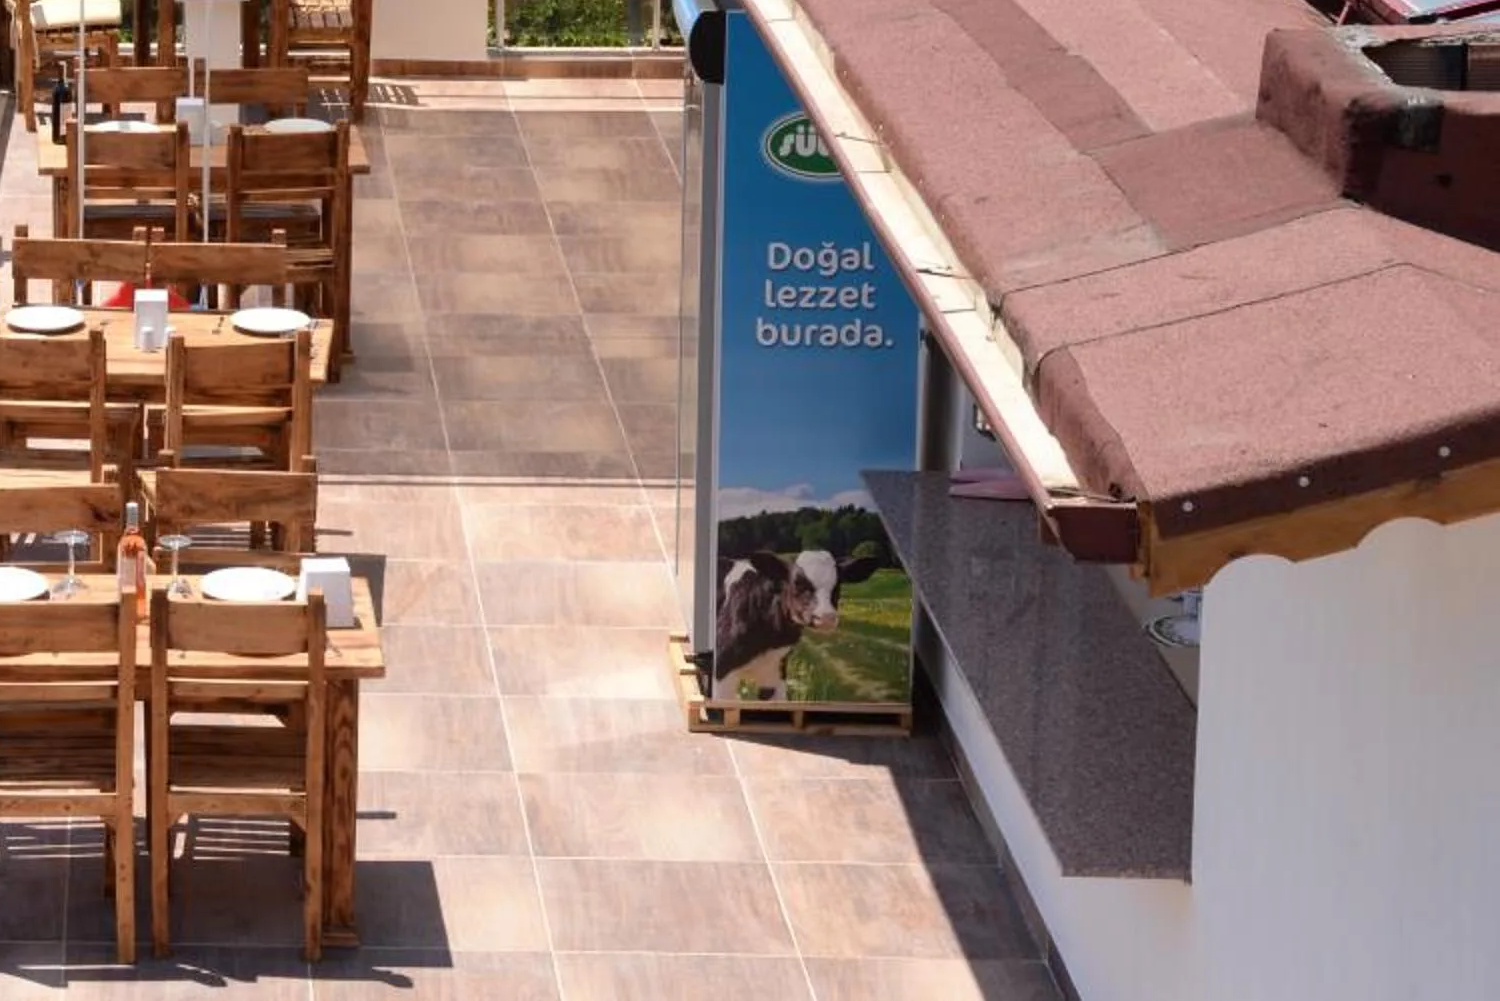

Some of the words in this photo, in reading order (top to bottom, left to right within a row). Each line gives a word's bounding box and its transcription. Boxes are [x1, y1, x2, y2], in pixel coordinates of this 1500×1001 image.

[767, 241, 875, 276] Doğal
[764, 278, 876, 309] lezzet
[755, 317, 894, 347] burada.
